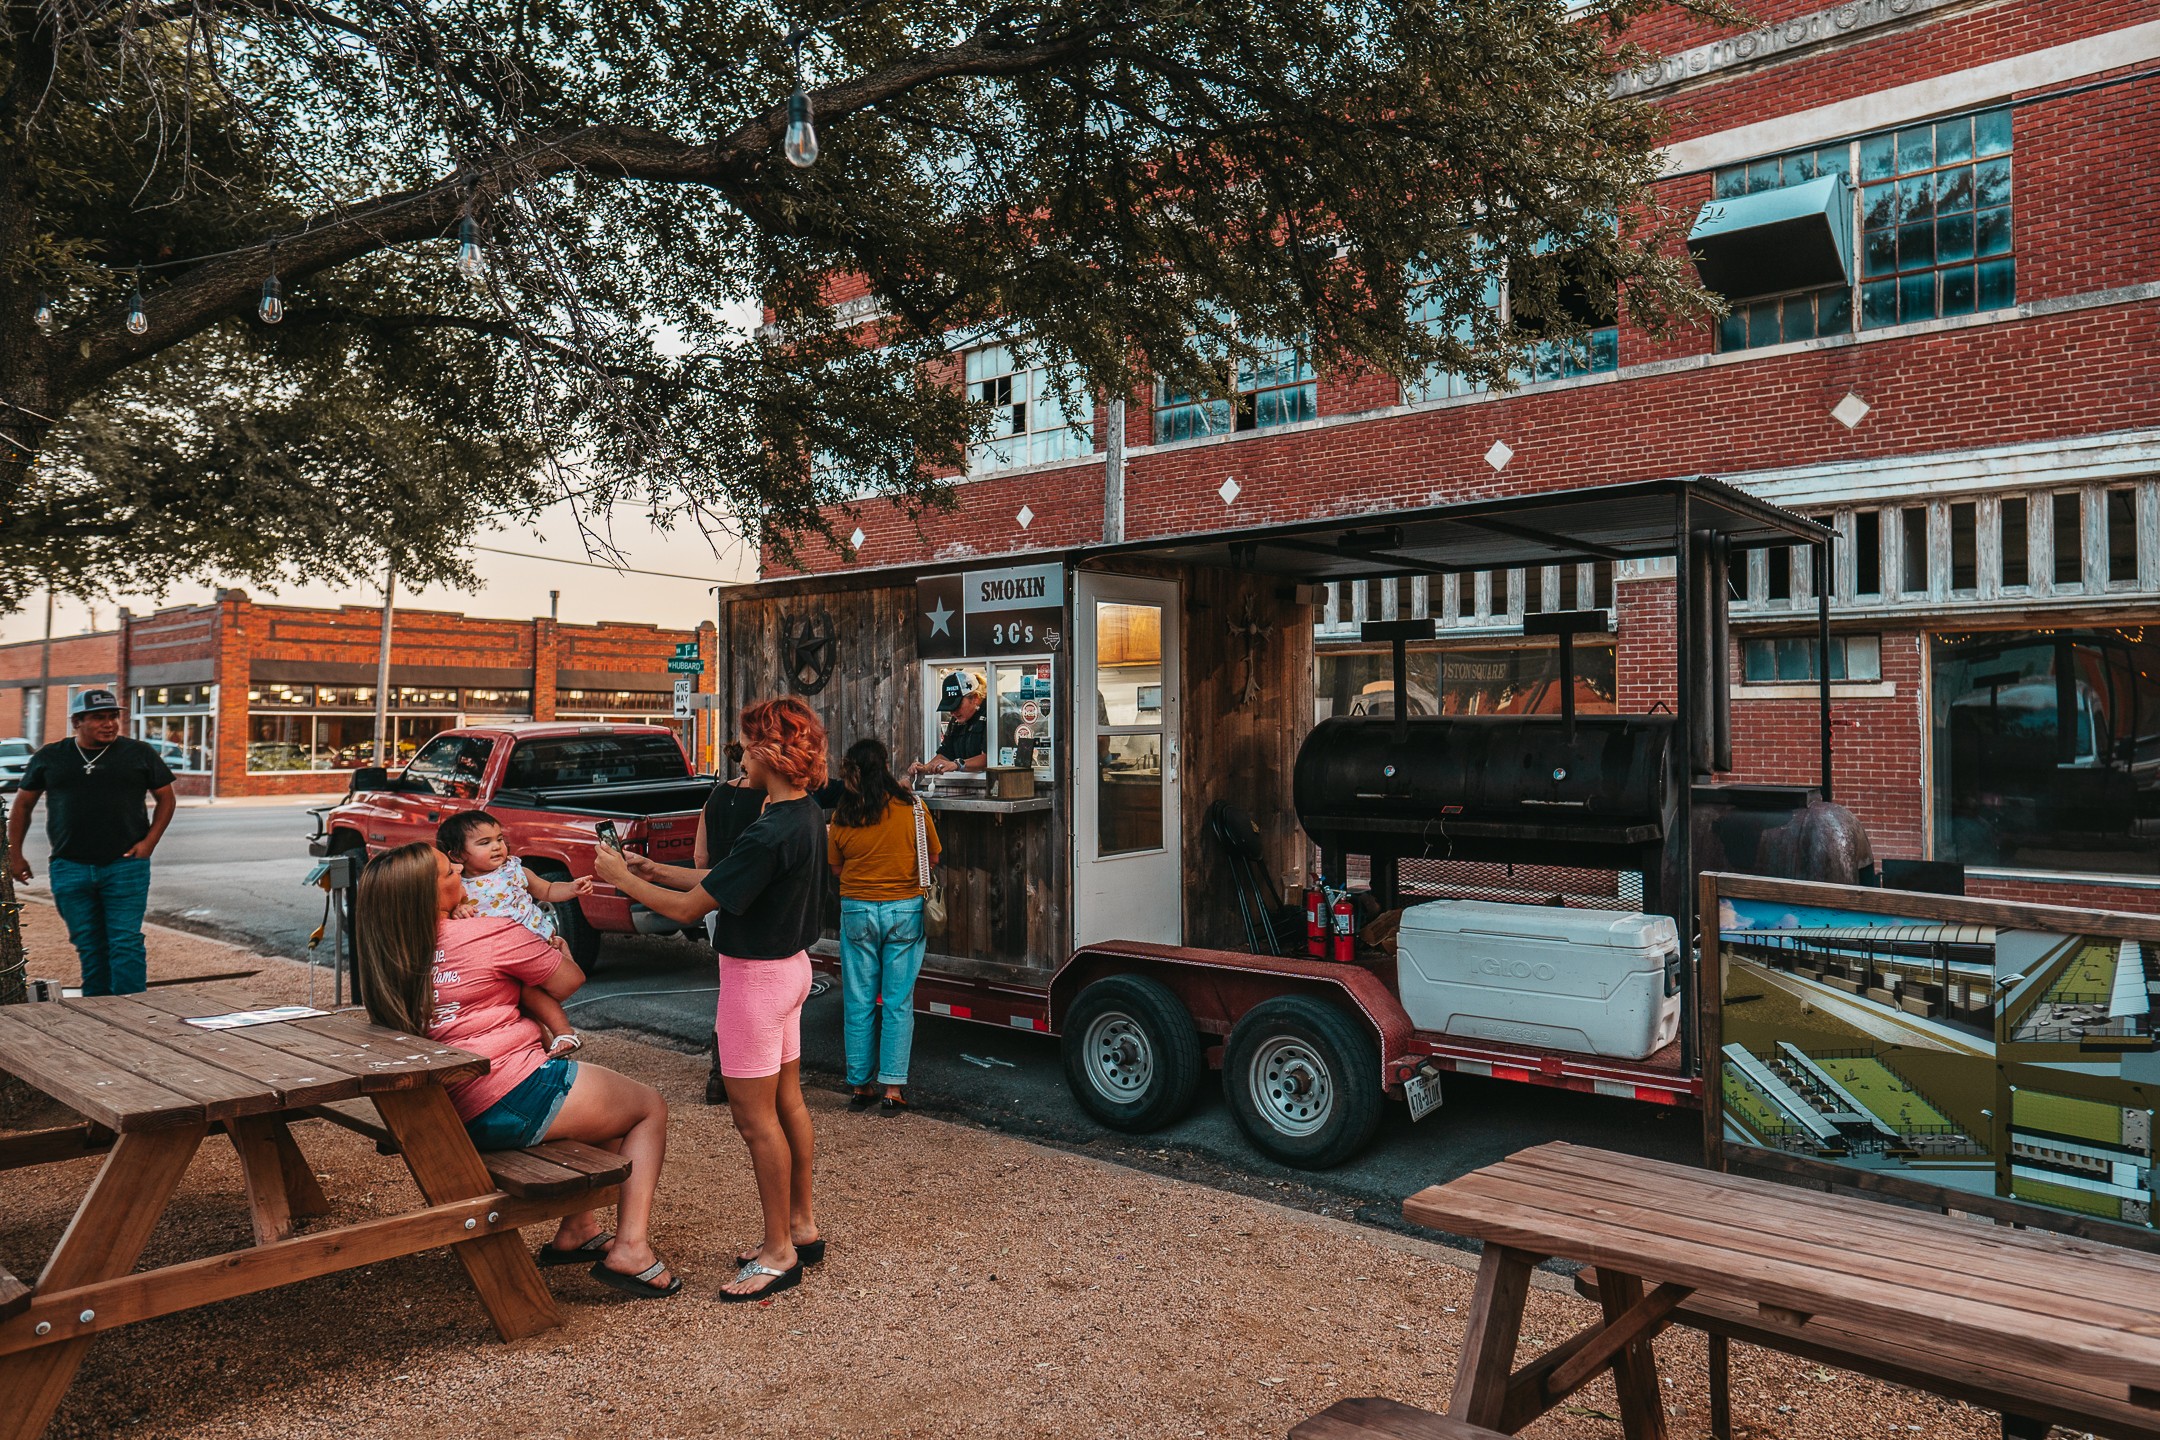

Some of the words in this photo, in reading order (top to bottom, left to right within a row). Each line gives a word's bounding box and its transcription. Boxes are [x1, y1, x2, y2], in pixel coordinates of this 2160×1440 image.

[981, 576, 1046, 602] SMOKIN
[672, 661, 701, 671] HUBBARD
[676, 683, 688, 692] ONE
[676, 694, 689, 703] WAY
[657, 837, 695, 849] DOD
[1471, 955, 1556, 981] IGLOO
